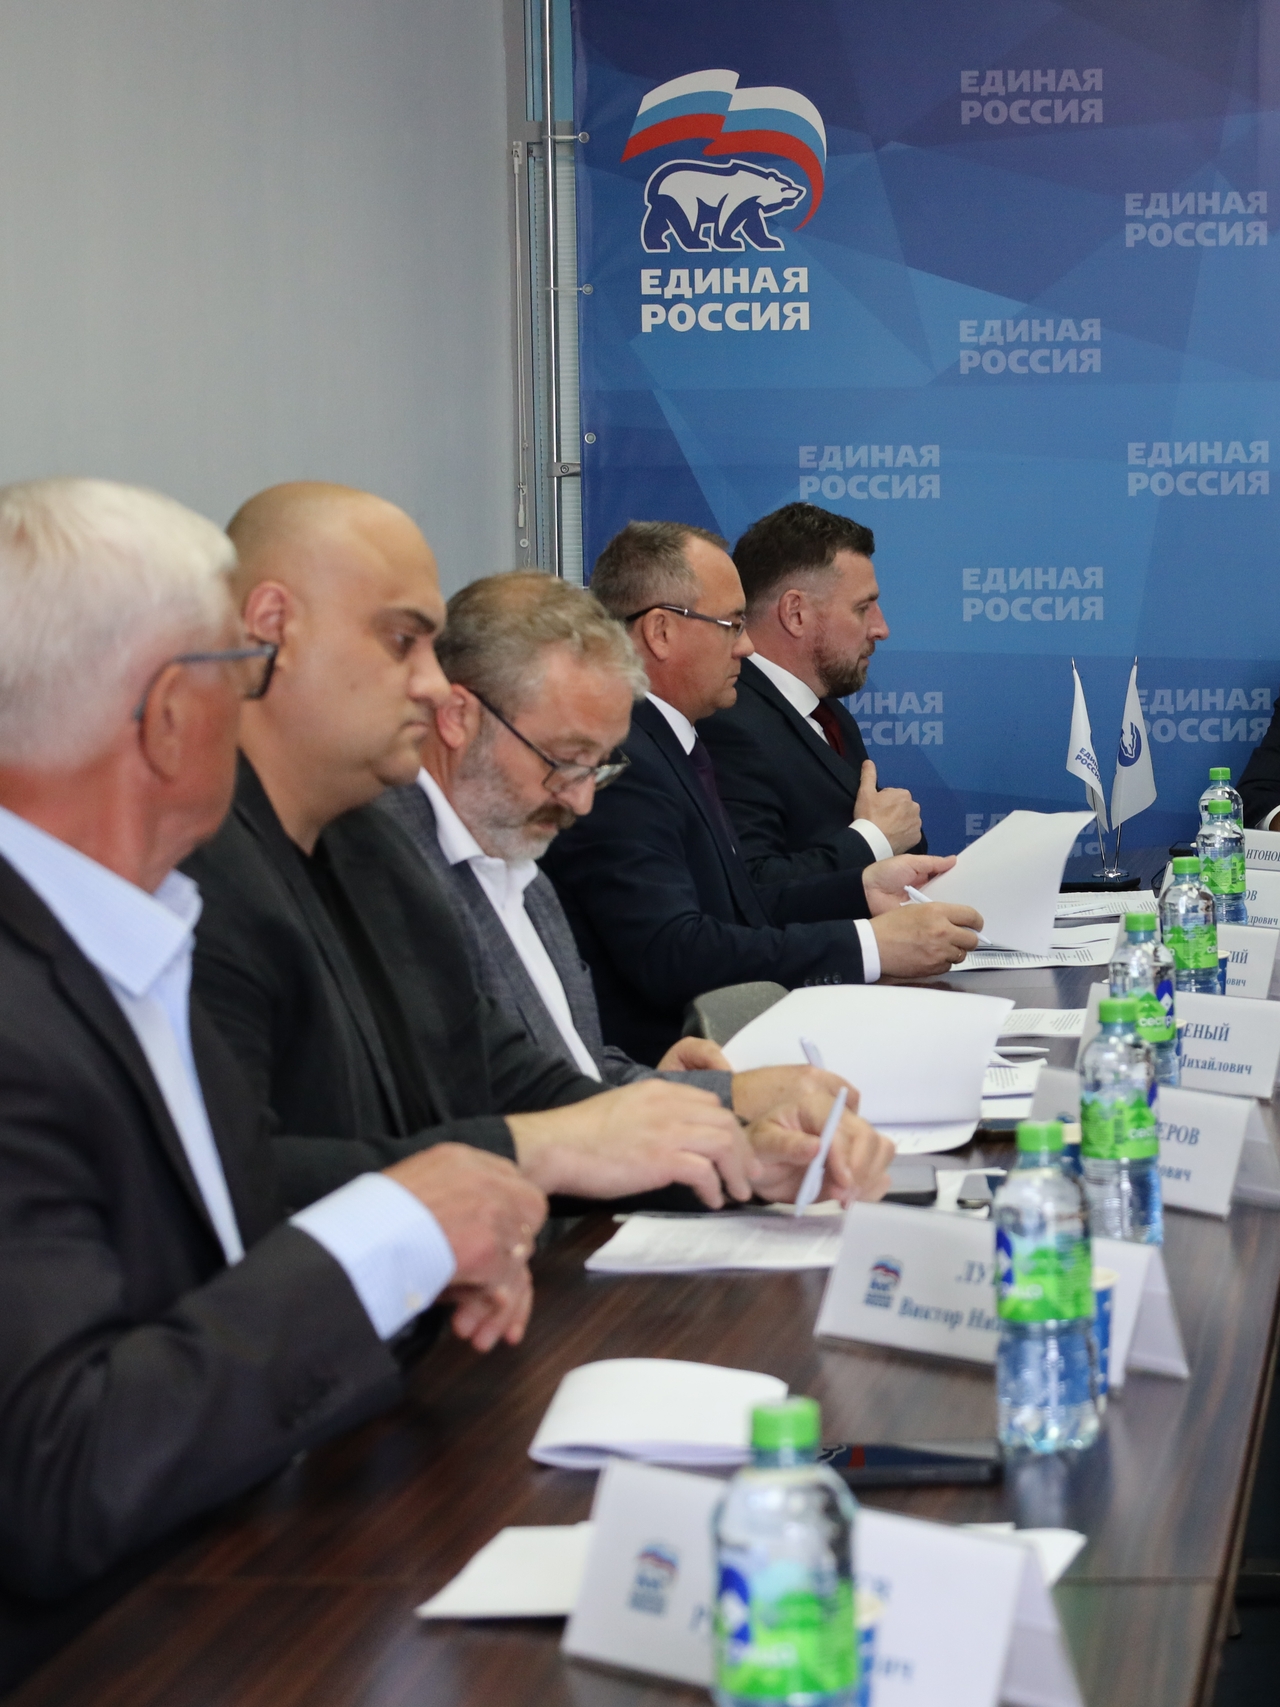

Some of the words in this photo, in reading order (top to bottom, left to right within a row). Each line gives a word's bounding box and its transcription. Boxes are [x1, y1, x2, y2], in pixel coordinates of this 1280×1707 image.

[960, 68, 1103, 95] ЕДИНАЯ
[960, 99, 1103, 125] РОССИЯ
[1125, 191, 1268, 218] ЕДИНАЯ
[1125, 221, 1268, 248] РОССИЯ
[640, 267, 809, 298] ЕДИНАЯ
[640, 302, 809, 332] РОССИЯ
[959, 319, 1101, 346] ЕДИНАЯ
[959, 348, 1101, 374] РОССИЯ
[800, 444, 941, 471] ЕДИНАЯ
[1127, 441, 1269, 468] ЕДИНАЯ
[800, 473, 941, 500] РОССИЯ
[1127, 470, 1269, 497] РОССИЯ
[962, 566, 1104, 593] ЕДИНАЯ
[962, 596, 1104, 622] РОССИЯ
[848, 691, 943, 714] ИНАЯ
[857, 720, 943, 746] ССИЯ
[1183, 1022, 1231, 1042] ЕНЫЙ
